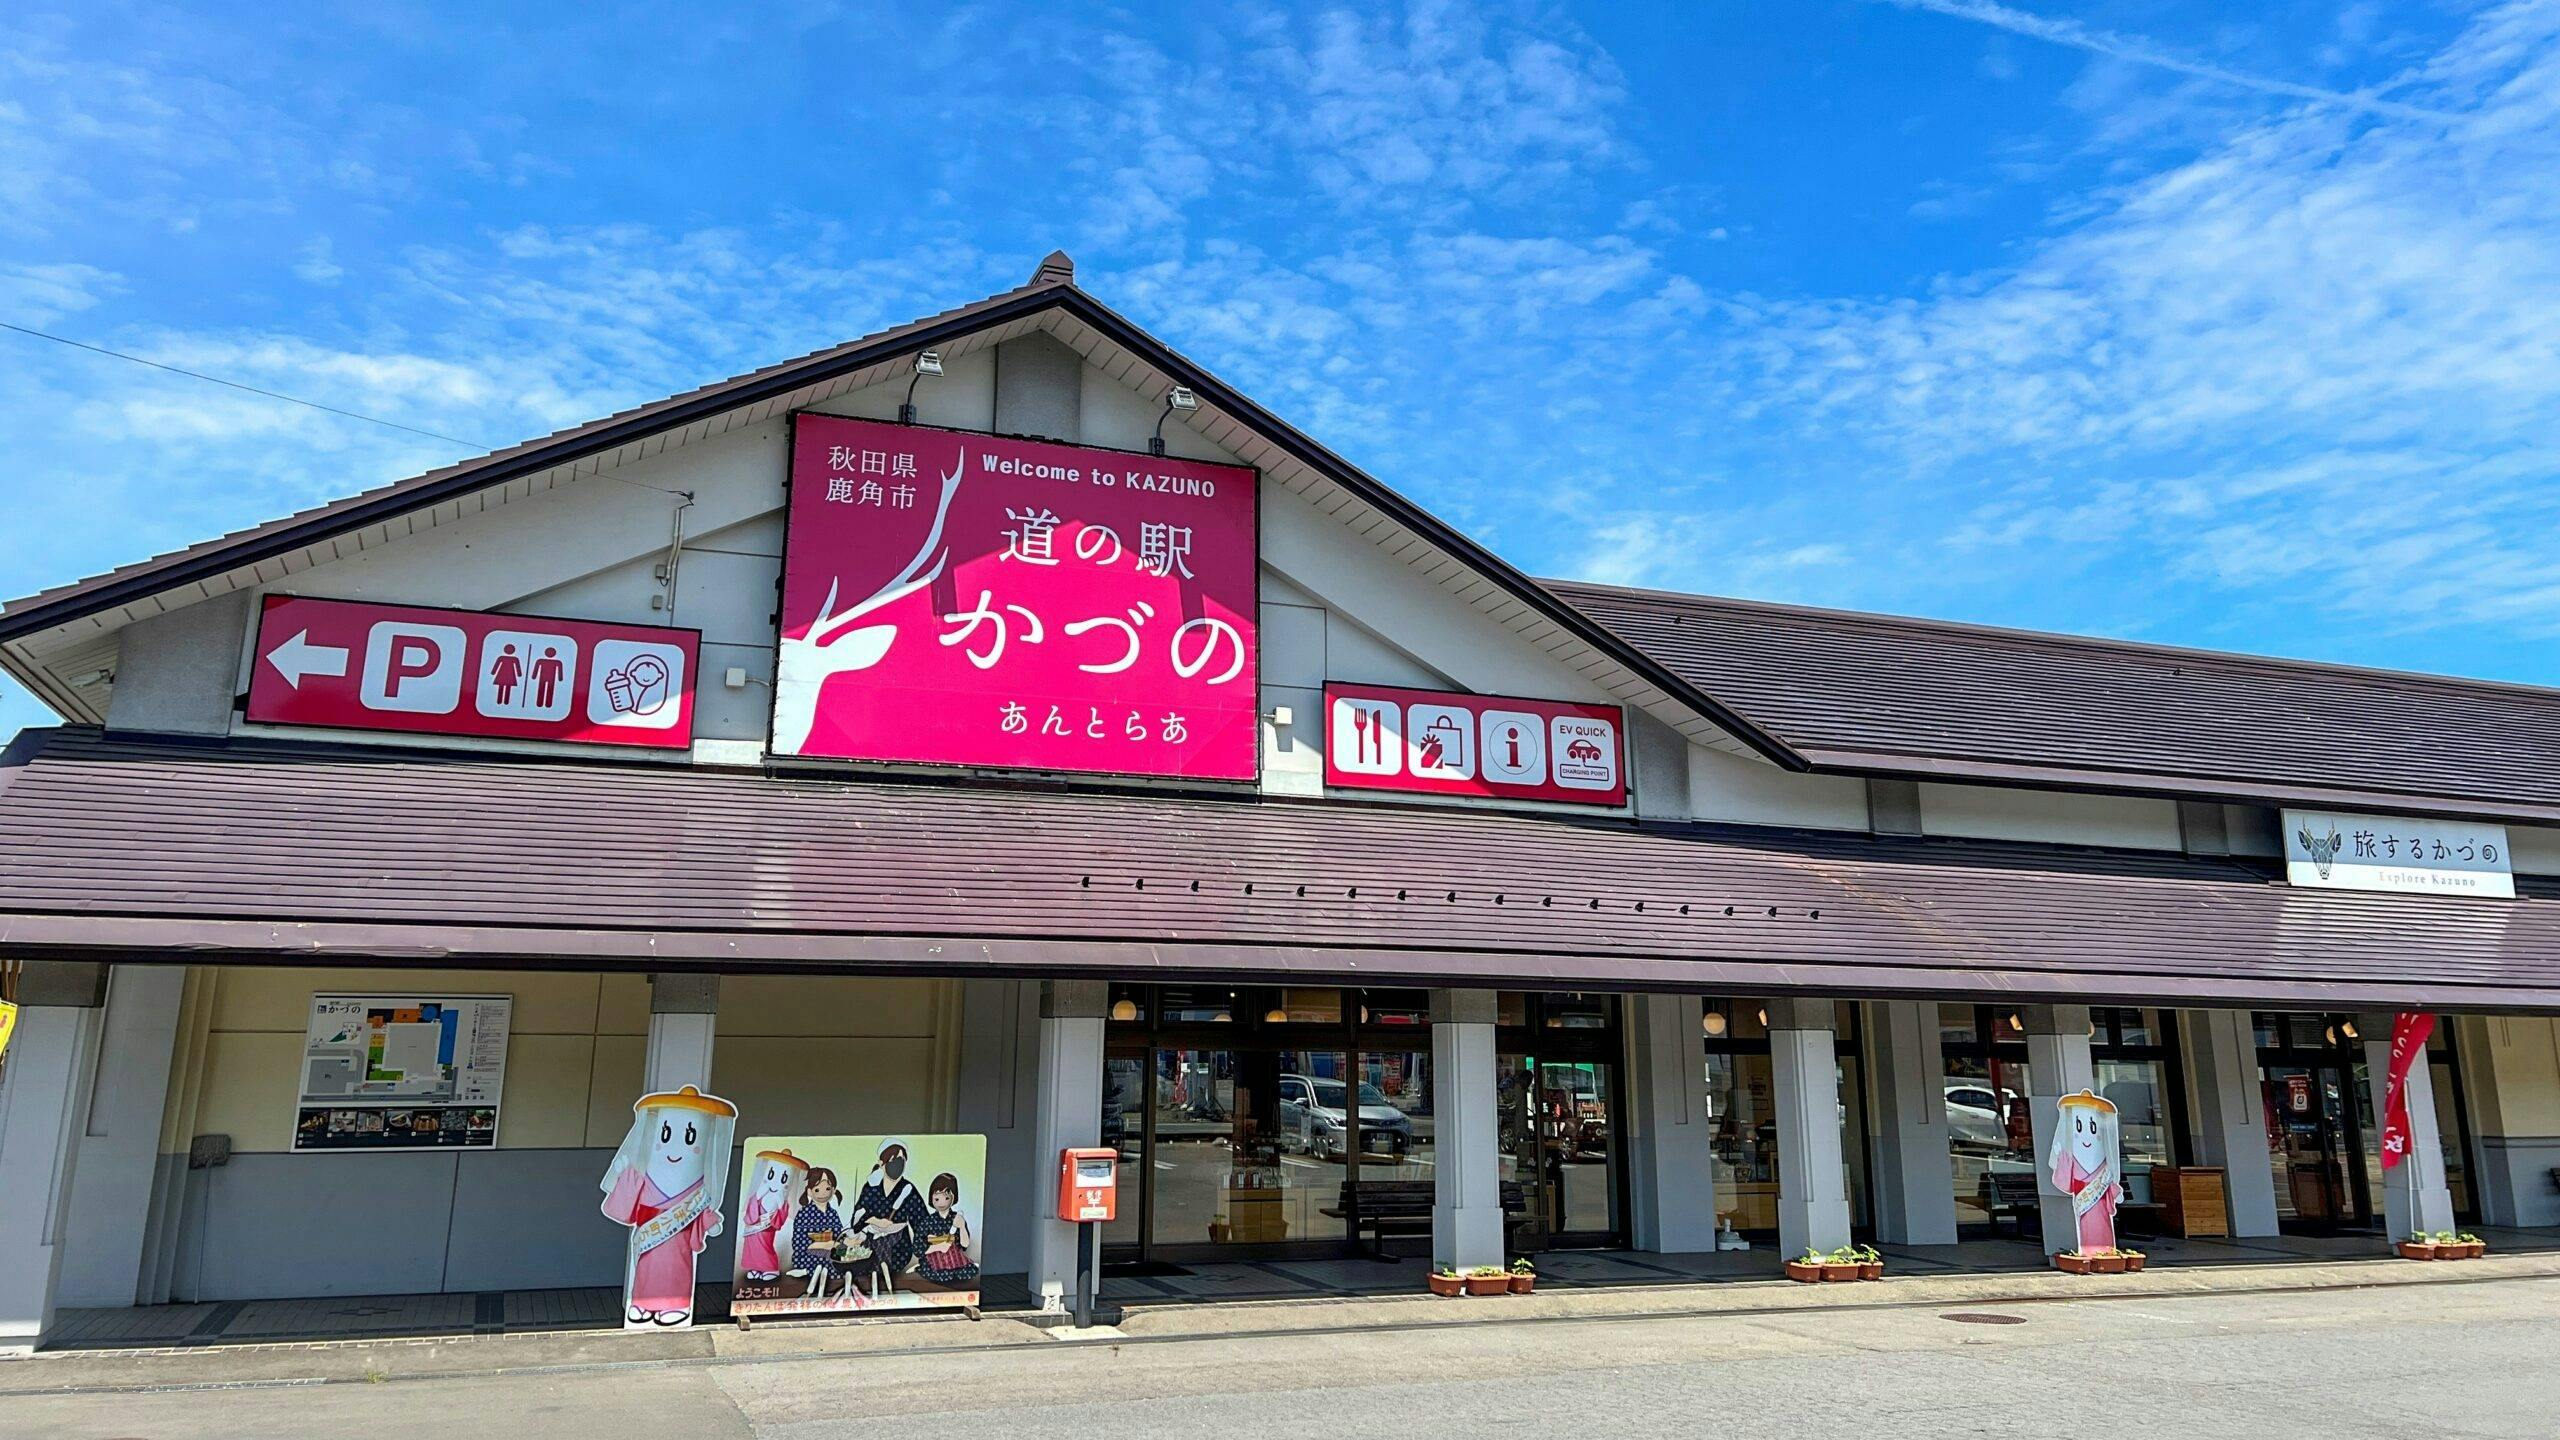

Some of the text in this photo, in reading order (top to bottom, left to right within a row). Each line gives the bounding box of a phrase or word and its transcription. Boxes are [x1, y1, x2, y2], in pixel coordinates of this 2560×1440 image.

[827, 446, 918, 478] 秋田県
[982, 454, 1215, 498] Welcome to KAZUNO
[825, 478, 917, 509] 鹿角市
[999, 507, 1195, 580] 道の駅
[938, 589, 1245, 685] かづの
[383, 634, 442, 698] P
[1000, 701, 1188, 744] あんとらあ
[1559, 725, 1607, 738] EV QUICK
[1562, 768, 1590, 776] CHARGING
[2353, 830, 2498, 864] 旅するかづの
[2379, 871, 2476, 887] Explore Kazuno
